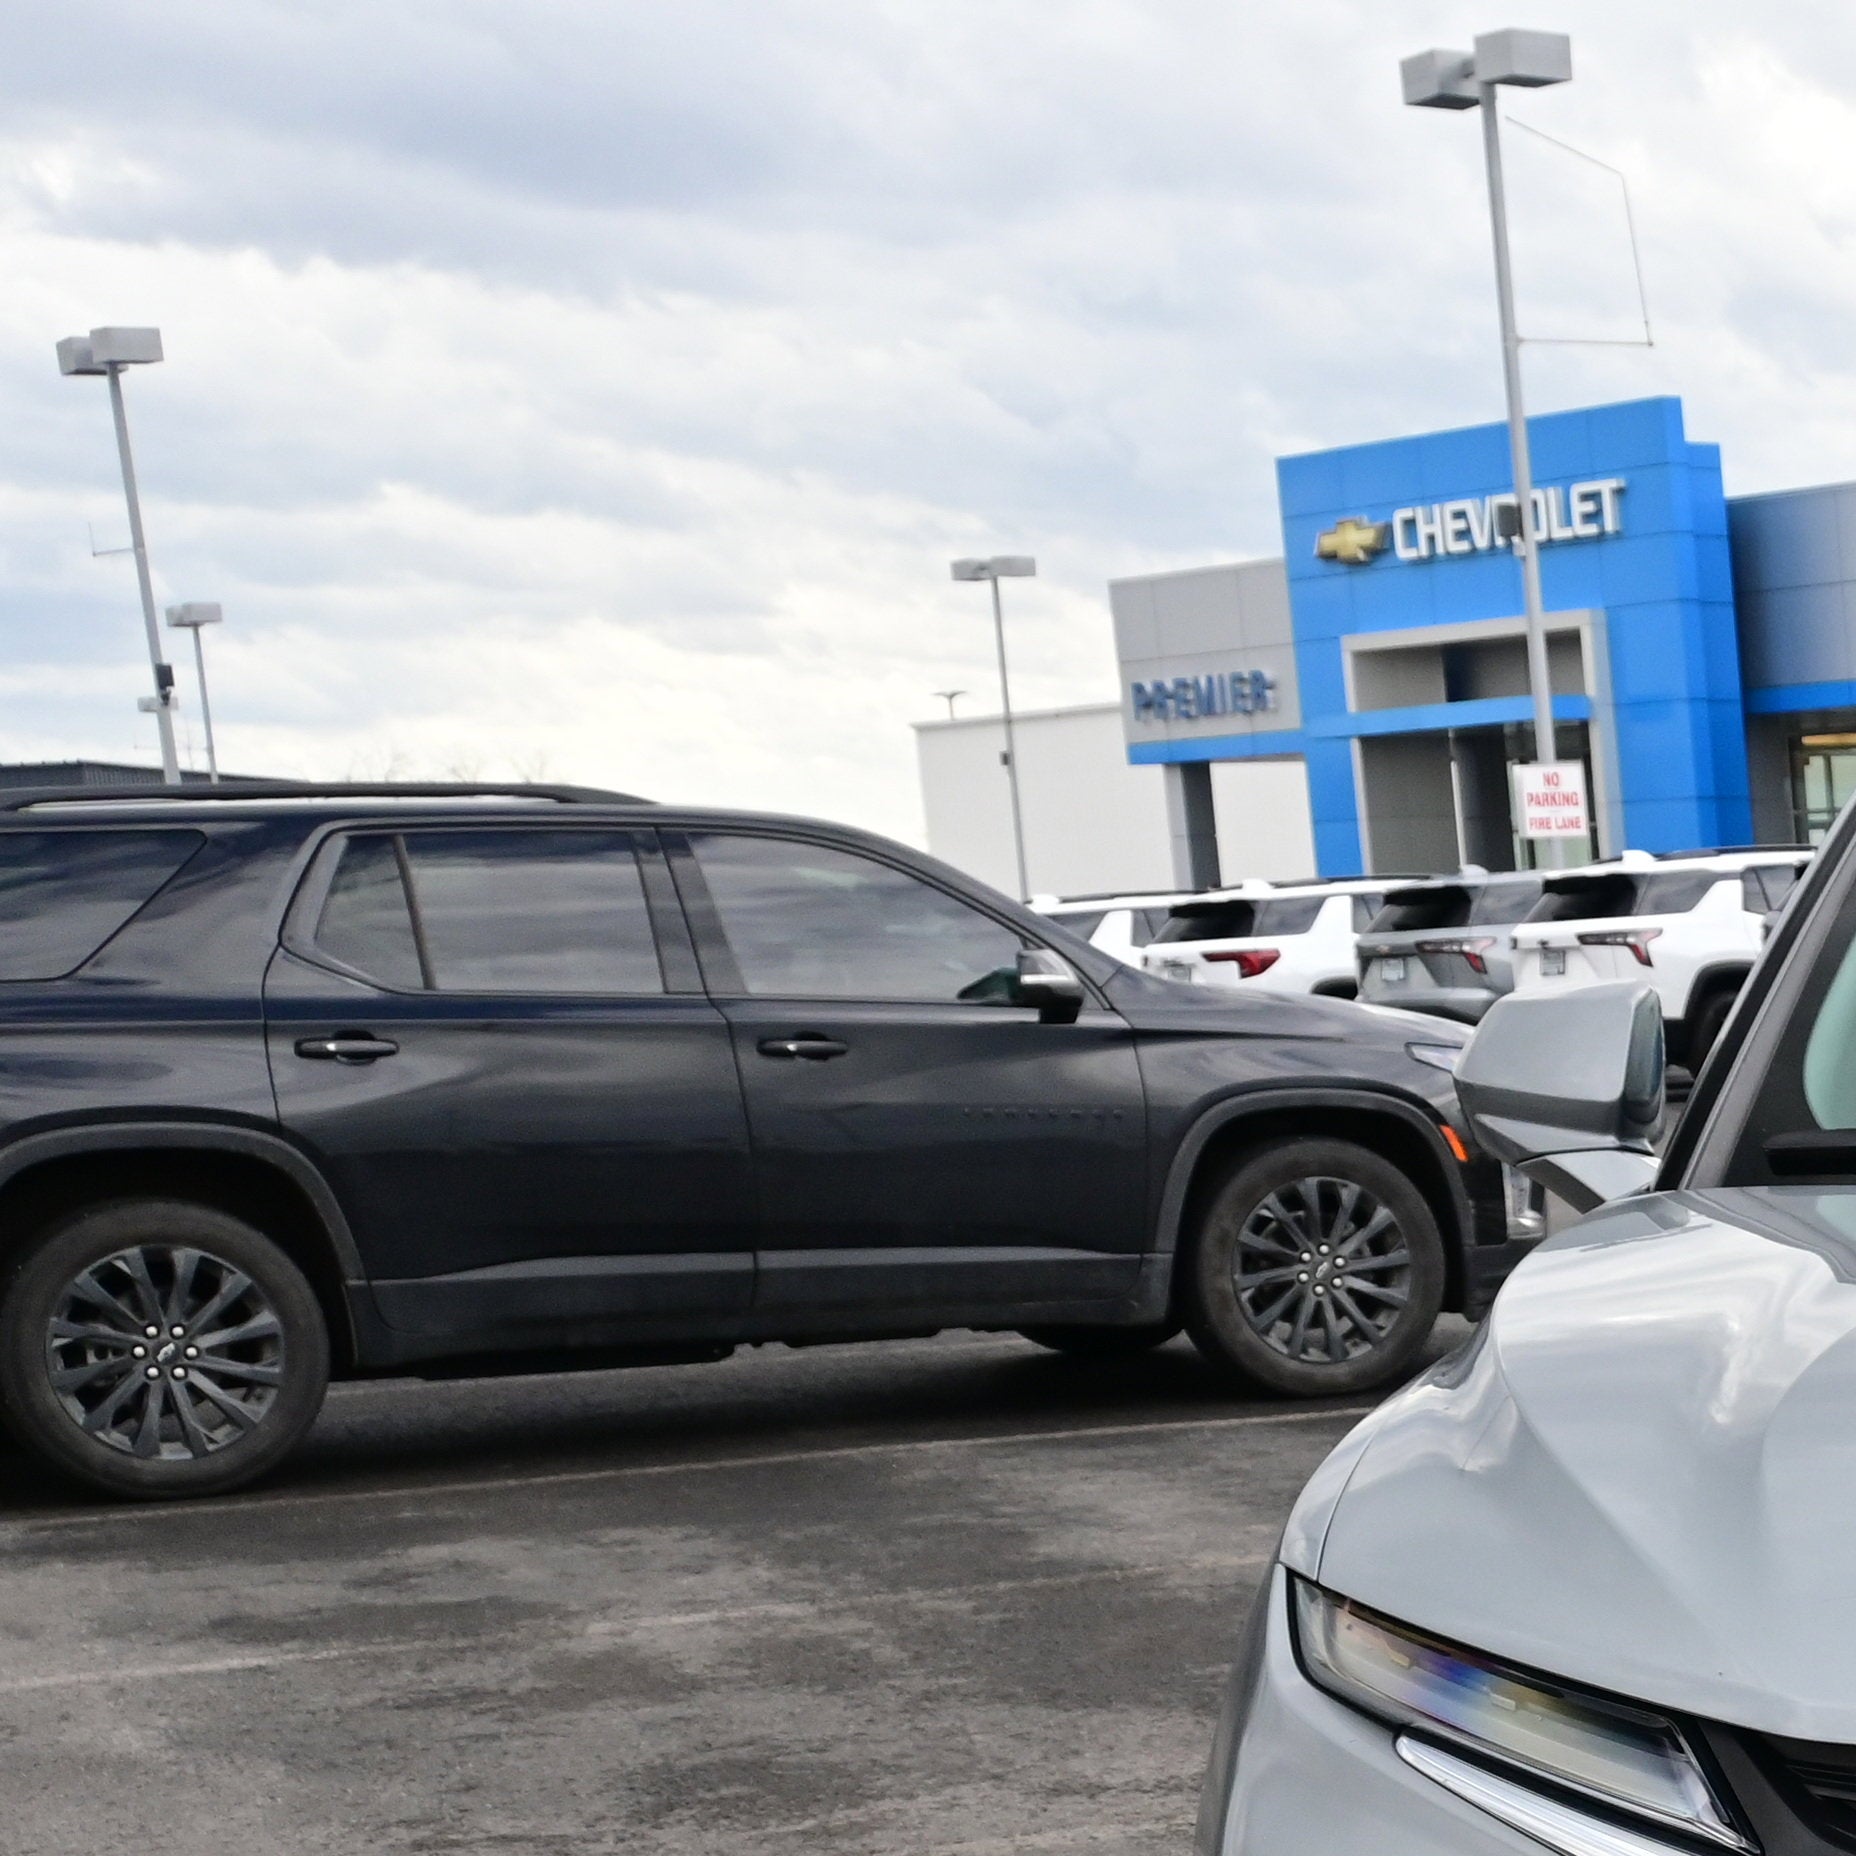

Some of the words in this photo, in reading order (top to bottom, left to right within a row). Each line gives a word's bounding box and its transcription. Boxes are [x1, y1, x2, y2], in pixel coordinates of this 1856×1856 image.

[1131, 669, 1276, 724] PREMIER
[1542, 771, 1560, 788] NO
[1526, 791, 1579, 808] PARKING
[1529, 816, 1552, 831] FIRE
[1554, 816, 1581, 830] LANE
